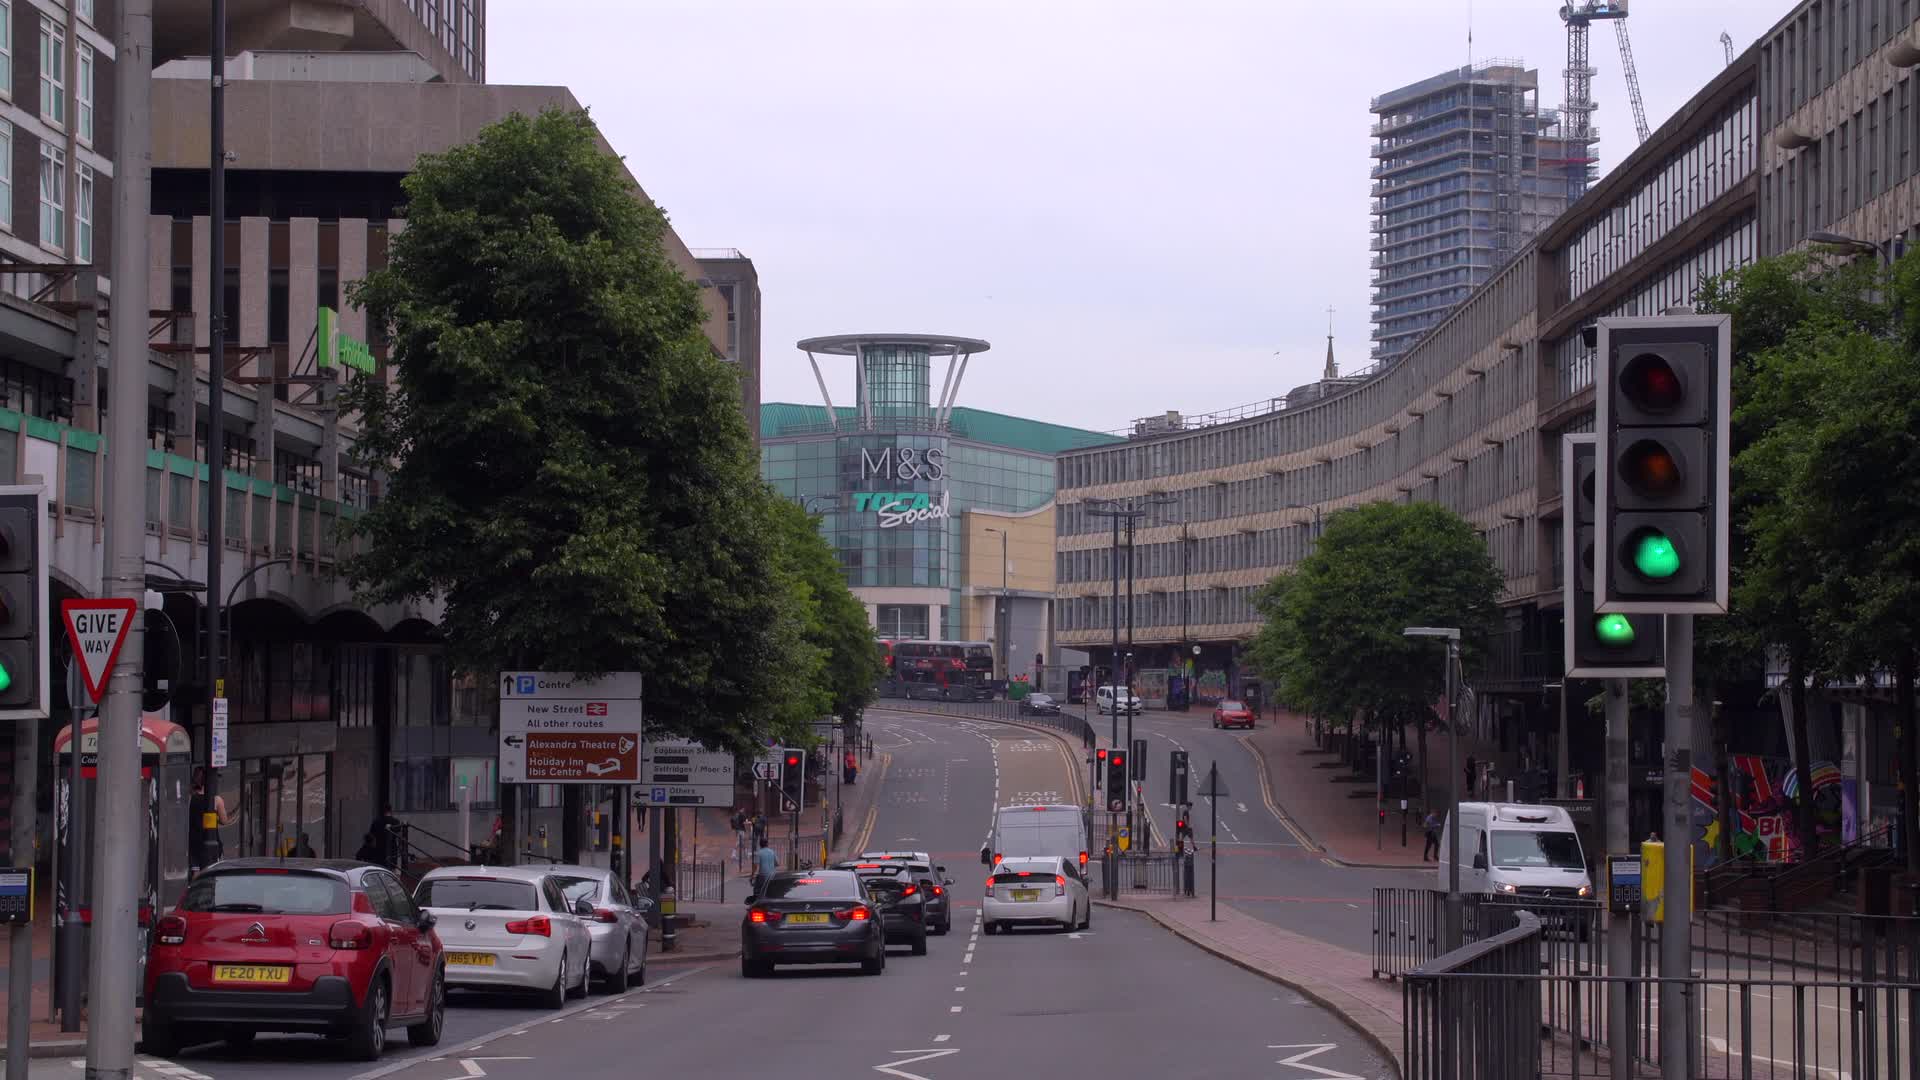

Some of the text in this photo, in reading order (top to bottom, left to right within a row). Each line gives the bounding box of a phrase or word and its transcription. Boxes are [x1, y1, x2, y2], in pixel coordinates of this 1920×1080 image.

[861, 447, 943, 481] M&S
[852, 492, 930, 512] TOCA
[878, 490, 951, 529] Social
[75, 613, 118, 634] GIVE
[84, 639, 111, 654] WAY
[538, 681, 571, 689] Centre
[527, 704, 584, 714] New Street
[527, 719, 604, 728] All other routes
[529, 740, 617, 749] Alexandra Theatre
[529, 757, 584, 768] Holiday Inn
[529, 767, 582, 776] Ibis Centre
[669, 787, 696, 795] Others
[220, 967, 283, 979] FE20 TXU
